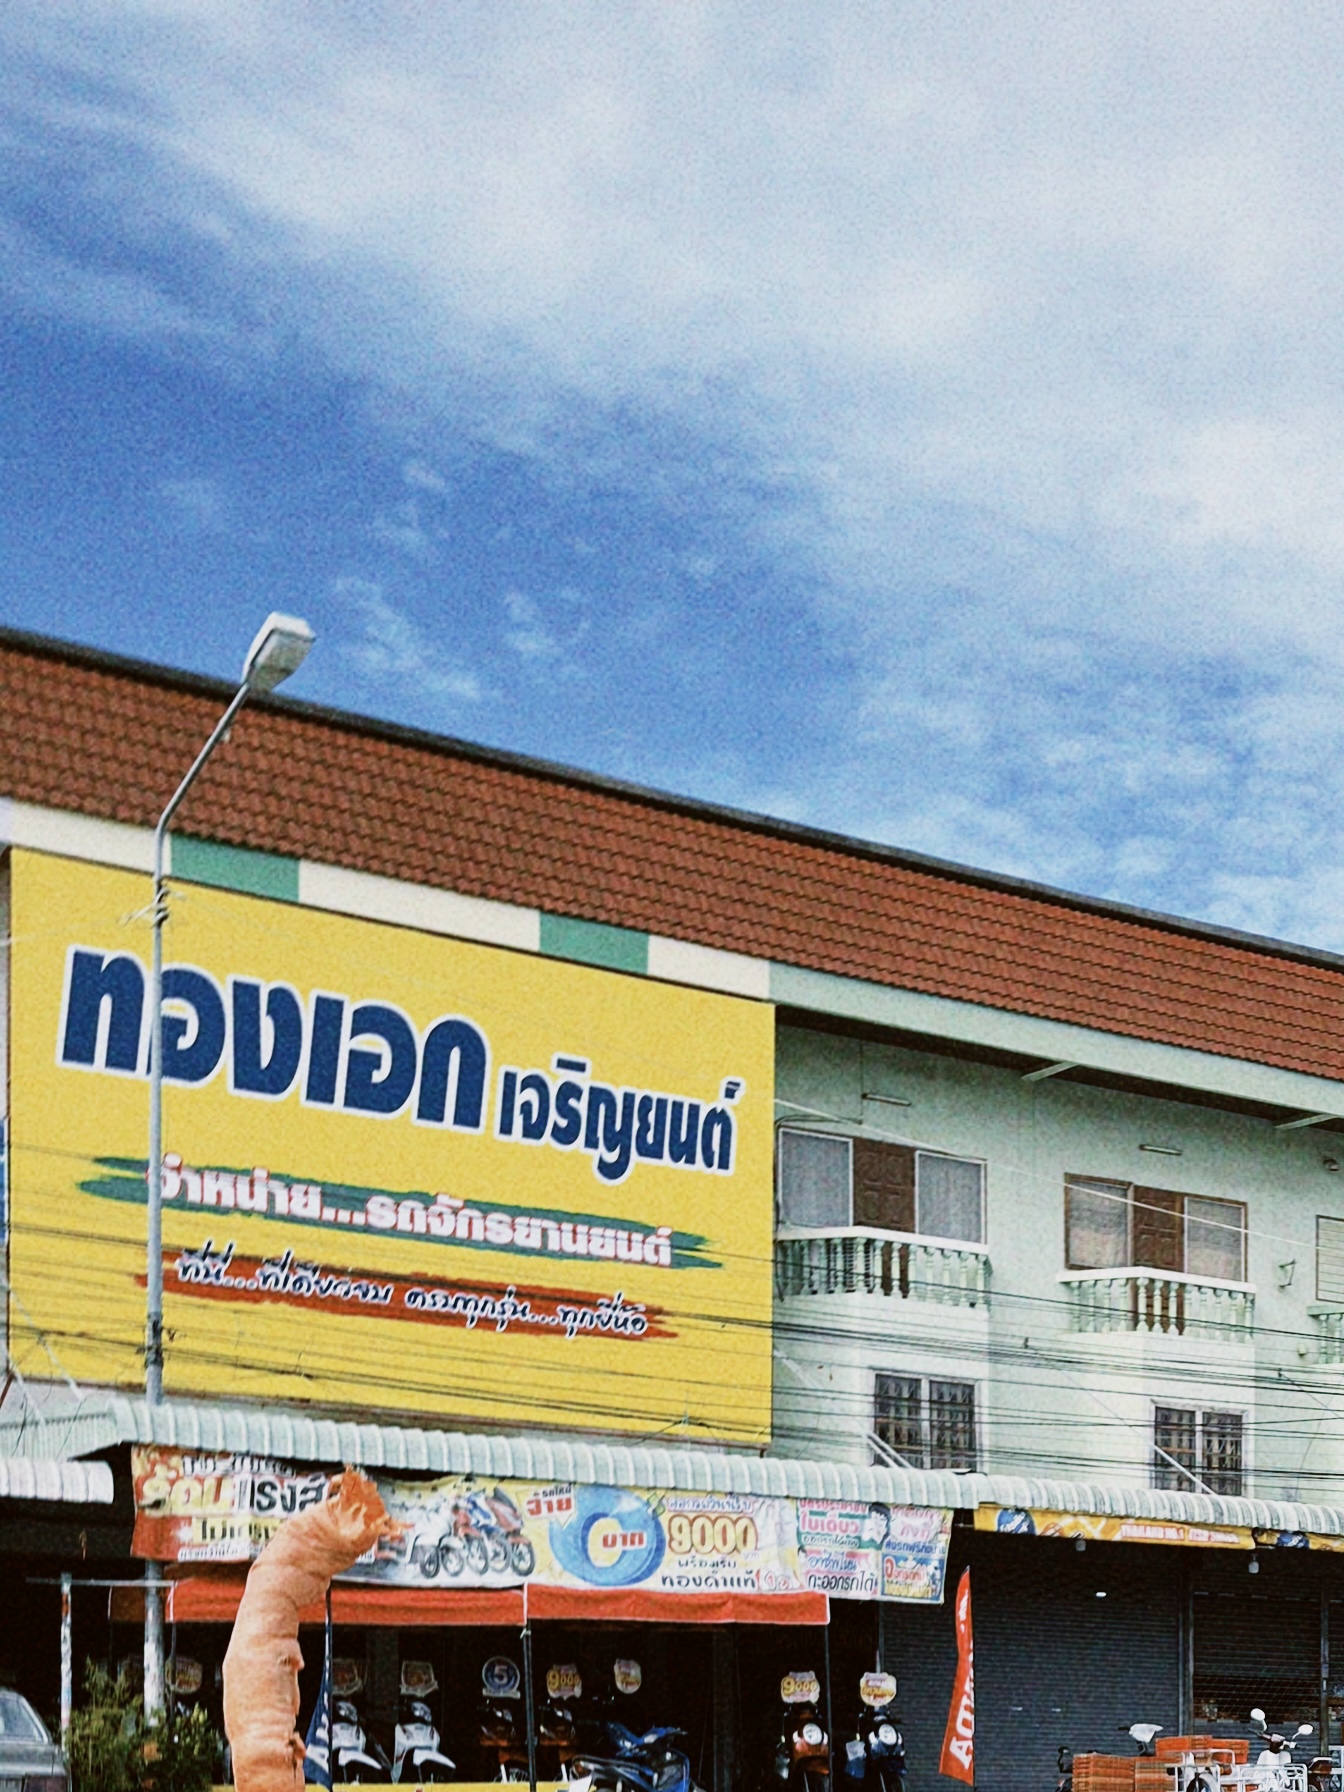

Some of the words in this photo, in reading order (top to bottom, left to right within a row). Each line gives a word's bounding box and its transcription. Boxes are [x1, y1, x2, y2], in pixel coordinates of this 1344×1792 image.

[60, 948, 489, 1131] ทองเอก
[501, 1058, 741, 1181] เจริญยนต์
[602, 1532, 644, 1548] บาท
[668, 1514, 758, 1554] 9000
